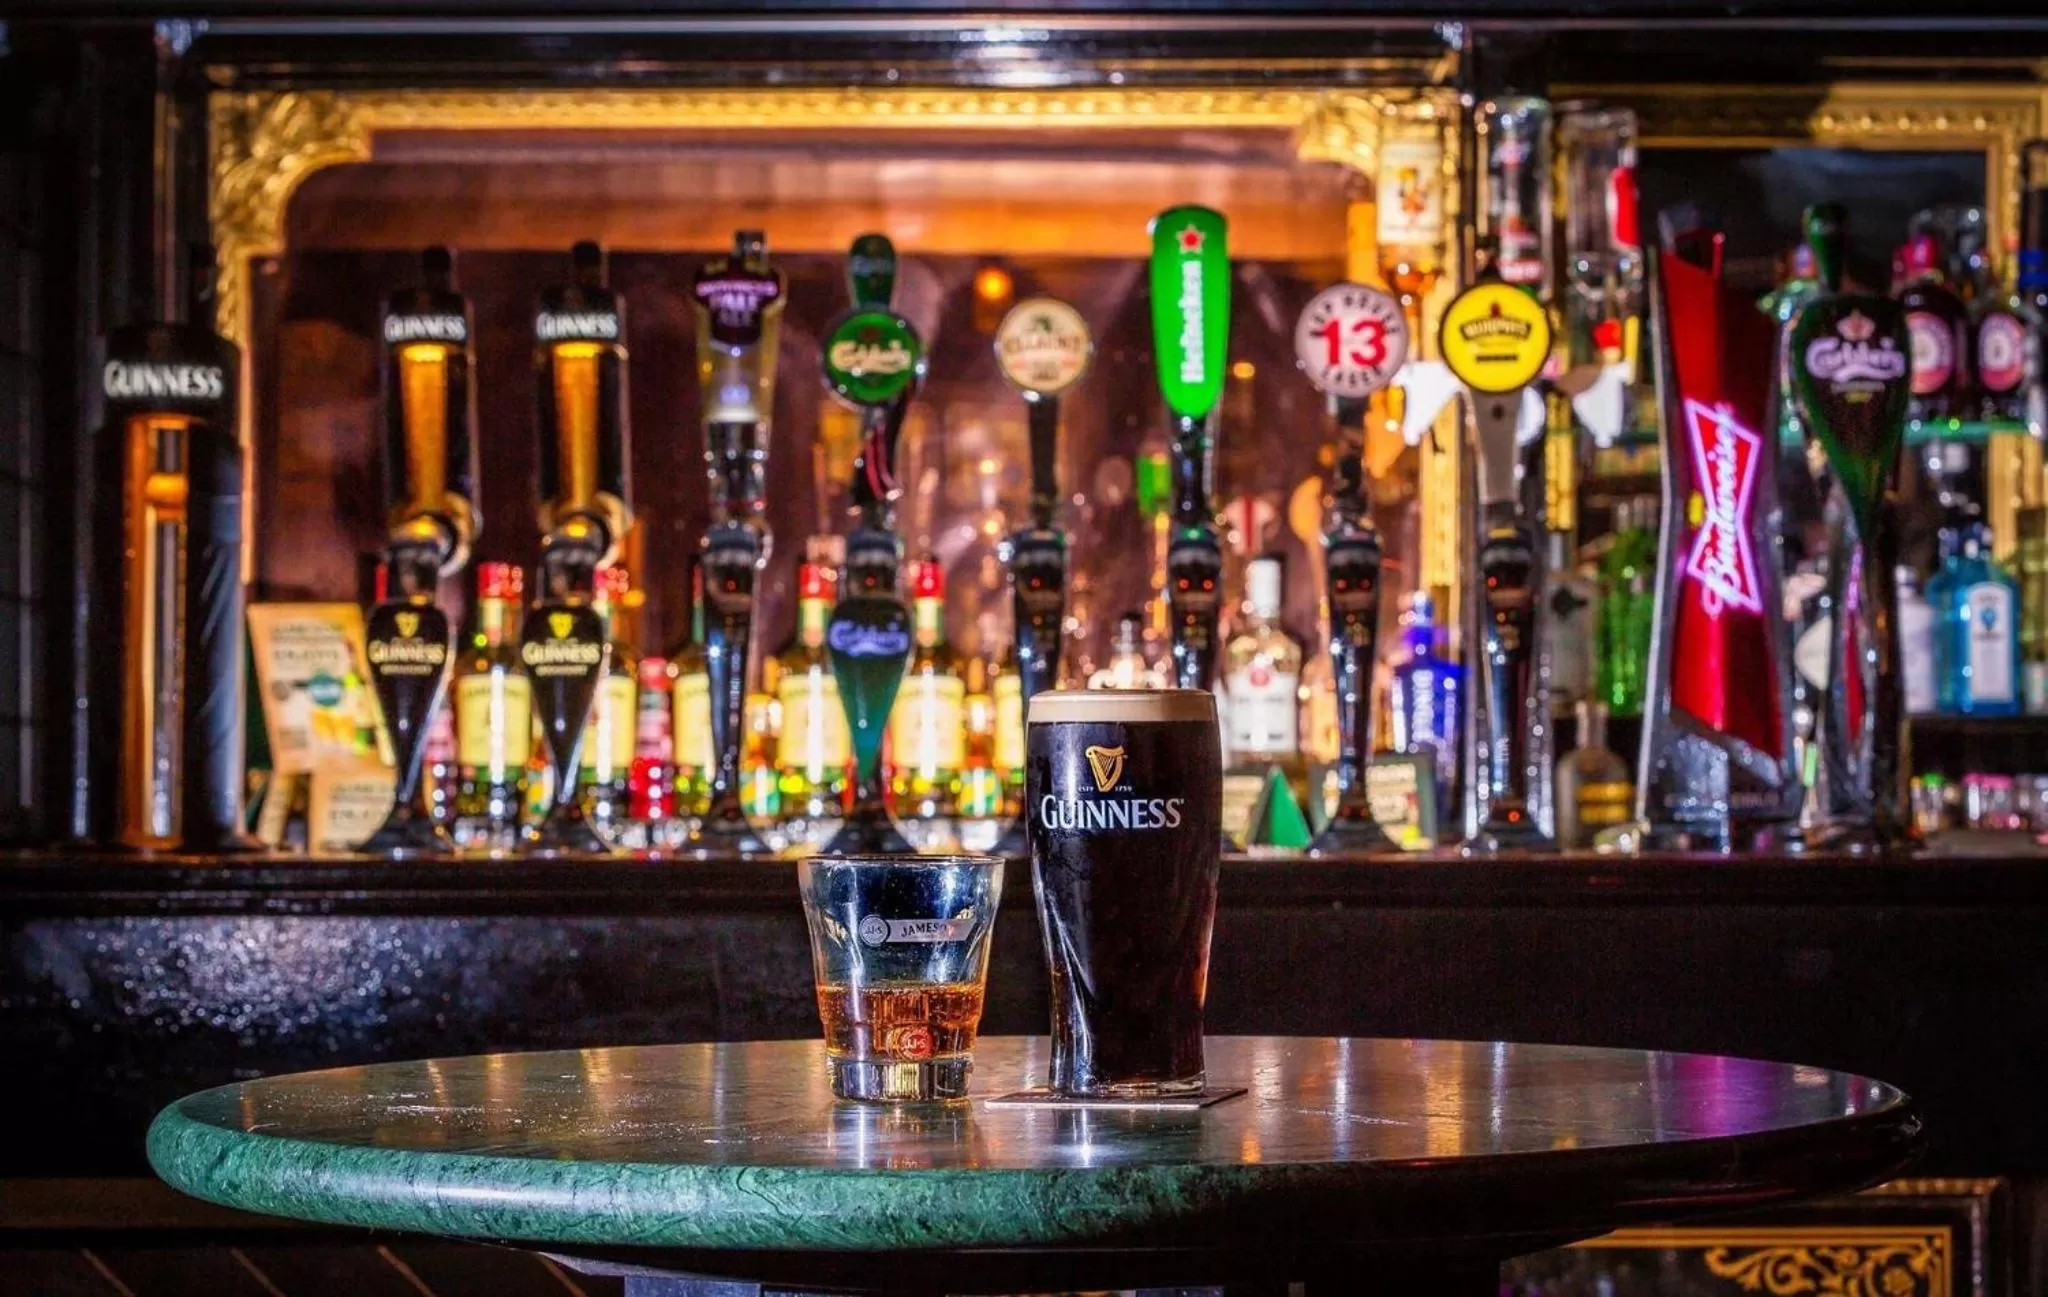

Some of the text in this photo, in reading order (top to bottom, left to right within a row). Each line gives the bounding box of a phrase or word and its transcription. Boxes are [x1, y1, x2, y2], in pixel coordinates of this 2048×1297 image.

[385, 315, 466, 341] GUINNESS
[537, 312, 617, 339] GUINNESS
[1178, 261, 1204, 383] Heineken
[1320, 318, 1388, 366] 13
[1805, 336, 1905, 382] Carlsberg
[104, 360, 222, 398] GUINNESS
[1703, 403, 1740, 618] Budweiser
[368, 640, 446, 665] GUINNESS
[521, 641, 600, 666] GUINNESS
[1041, 794, 1184, 830] GUINNESS
